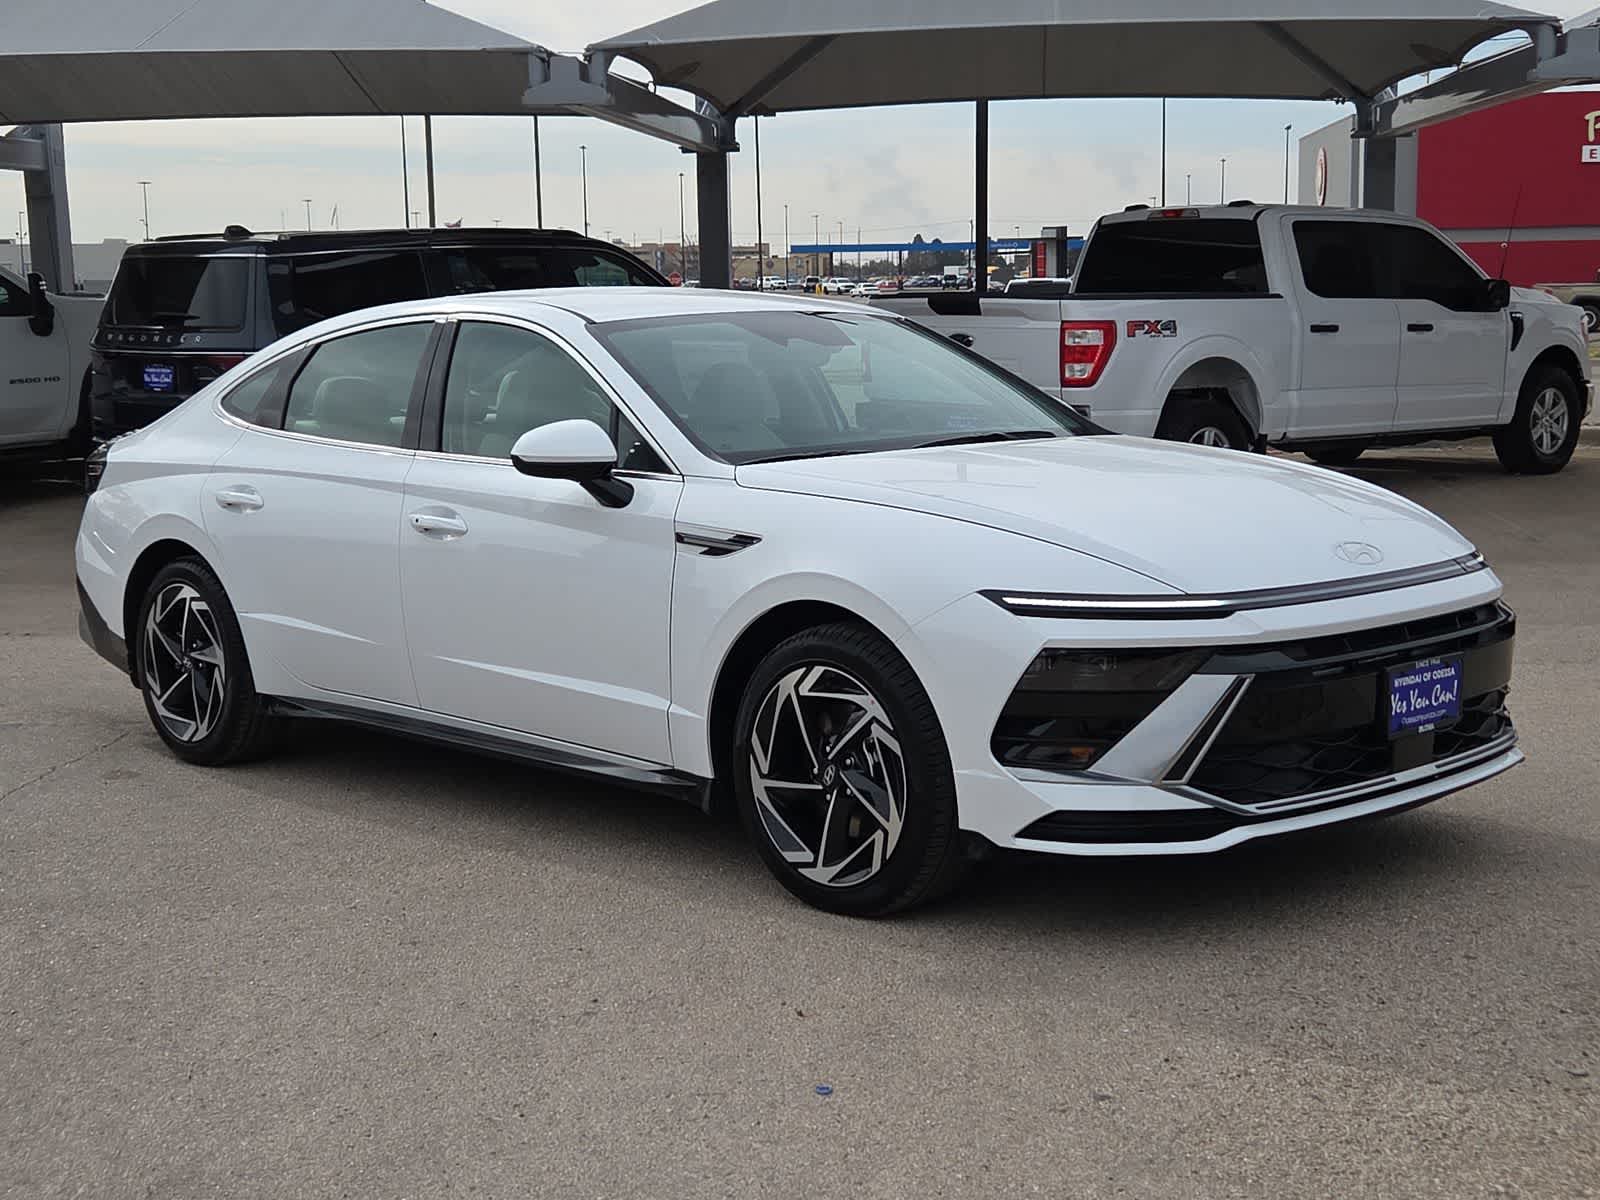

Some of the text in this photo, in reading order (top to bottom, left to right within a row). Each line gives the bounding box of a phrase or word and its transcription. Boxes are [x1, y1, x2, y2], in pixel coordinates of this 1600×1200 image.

[1127, 320, 1177, 337] FX4
[9, 377, 41, 385] 2500
[1394, 667, 1456, 688] HYUNDAI OF ODESSA
[1391, 680, 1458, 716] Yes You Can!
